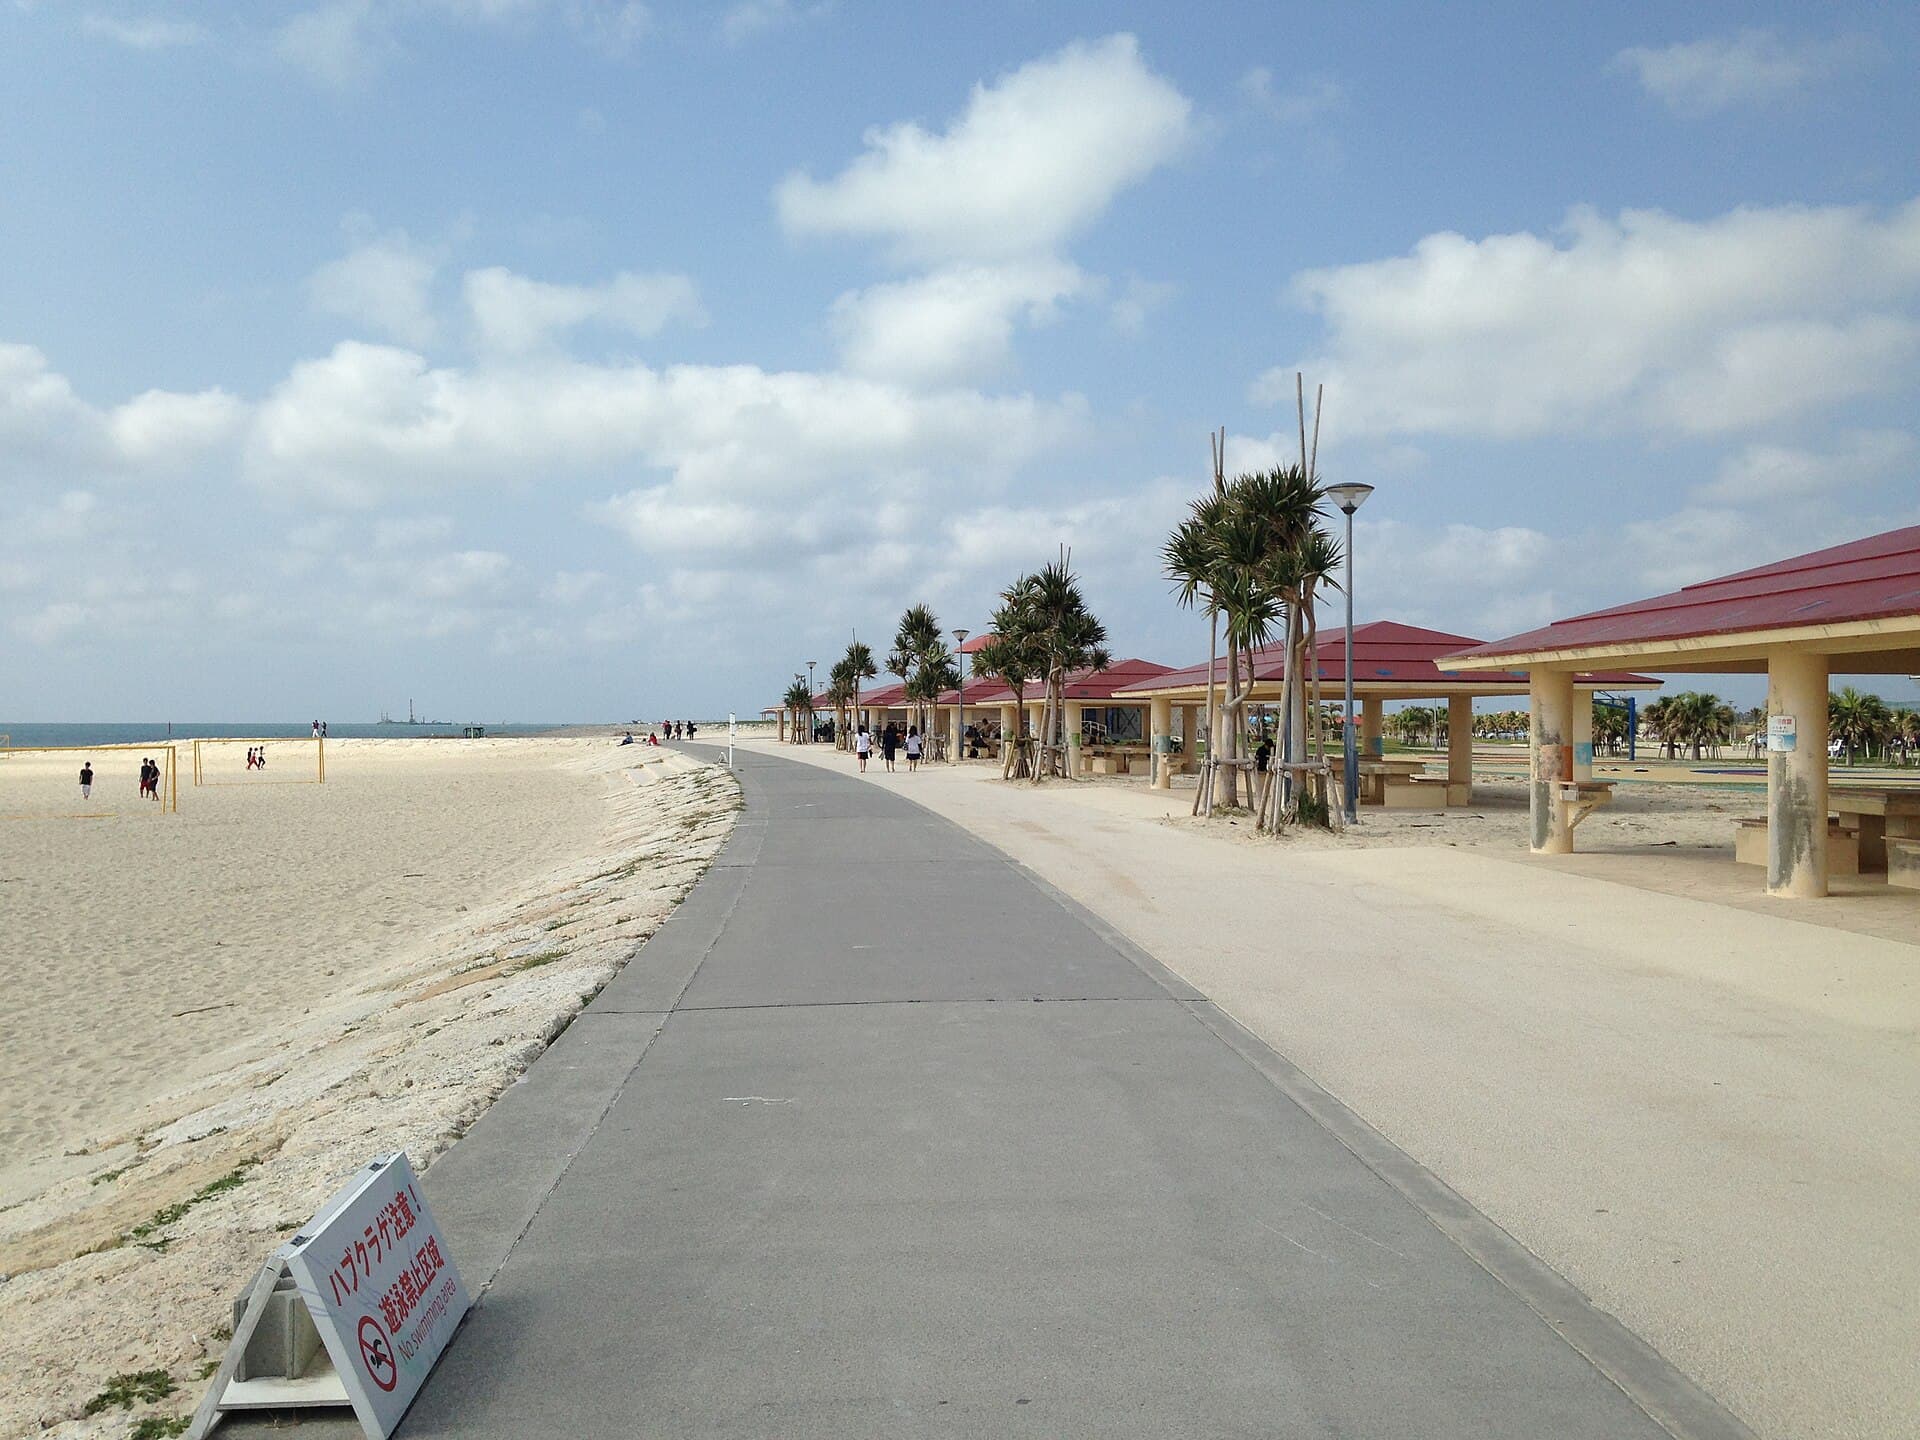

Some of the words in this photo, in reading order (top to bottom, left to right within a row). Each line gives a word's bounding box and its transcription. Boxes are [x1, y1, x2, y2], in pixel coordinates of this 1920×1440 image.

[378, 1235, 445, 1336] 遊泳禁止区域
[398, 1340, 415, 1365] No
[411, 1295, 447, 1350] swimming
[440, 1277, 457, 1304] area
